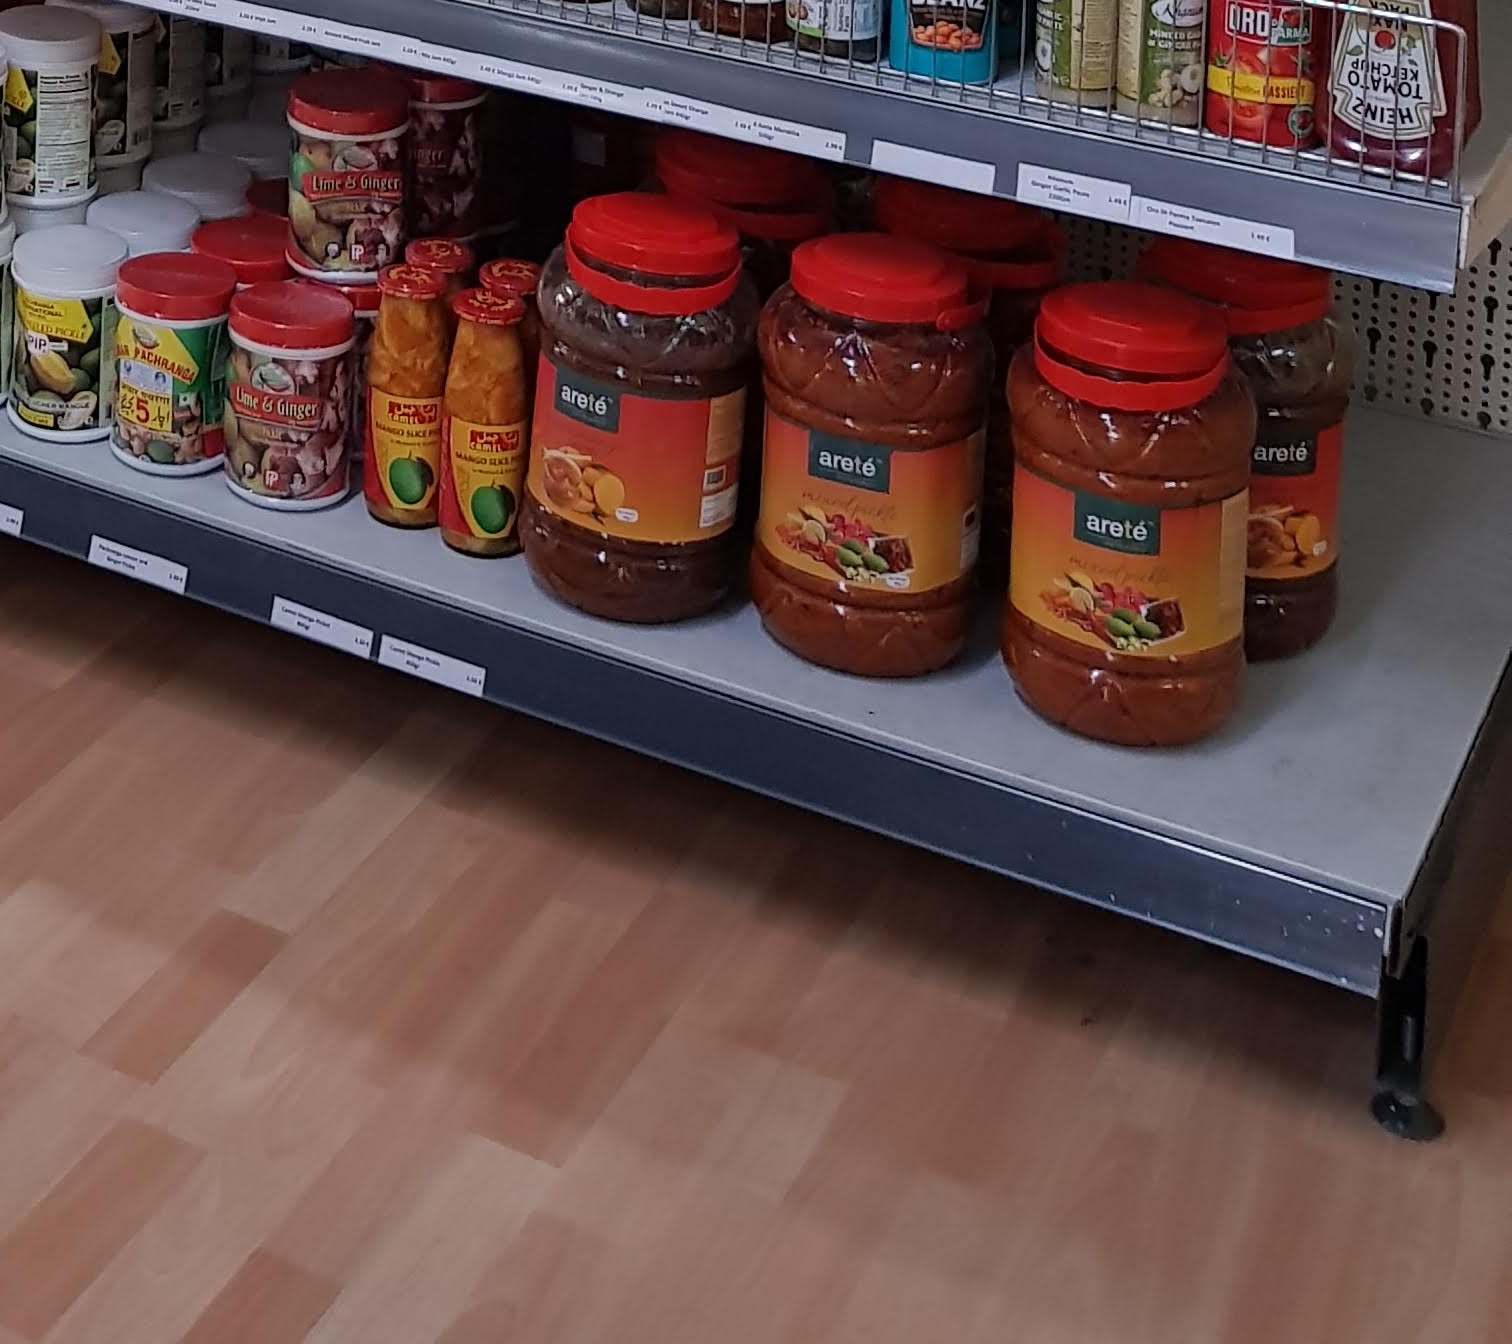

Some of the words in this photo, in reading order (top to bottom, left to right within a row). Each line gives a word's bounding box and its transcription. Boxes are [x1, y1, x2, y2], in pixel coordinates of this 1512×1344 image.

[1228, 4, 1271, 36] ORO
[1350, 58, 1420, 82] KETCHUP
[1347, 69, 1424, 101] TOMATO
[1351, 96, 1415, 125] HEINZ
[311, 172, 341, 193] Lime
[360, 172, 402, 195] Ginger
[27, 336, 48, 352] PIP
[55, 327, 88, 342] PICKLE
[133, 348, 197, 385] PACHRANGA
[135, 398, 150, 425] 5
[235, 386, 260, 411] Lime
[262, 395, 275, 412] &
[276, 397, 320, 420] Ginger
[560, 381, 608, 416] areté
[404, 426, 429, 440] SLICE
[455, 450, 484, 465] MANGO
[484, 454, 507, 466] SLICE
[818, 447, 878, 478] areté
[1253, 440, 1309, 463] areté
[1086, 513, 1149, 543] areté
